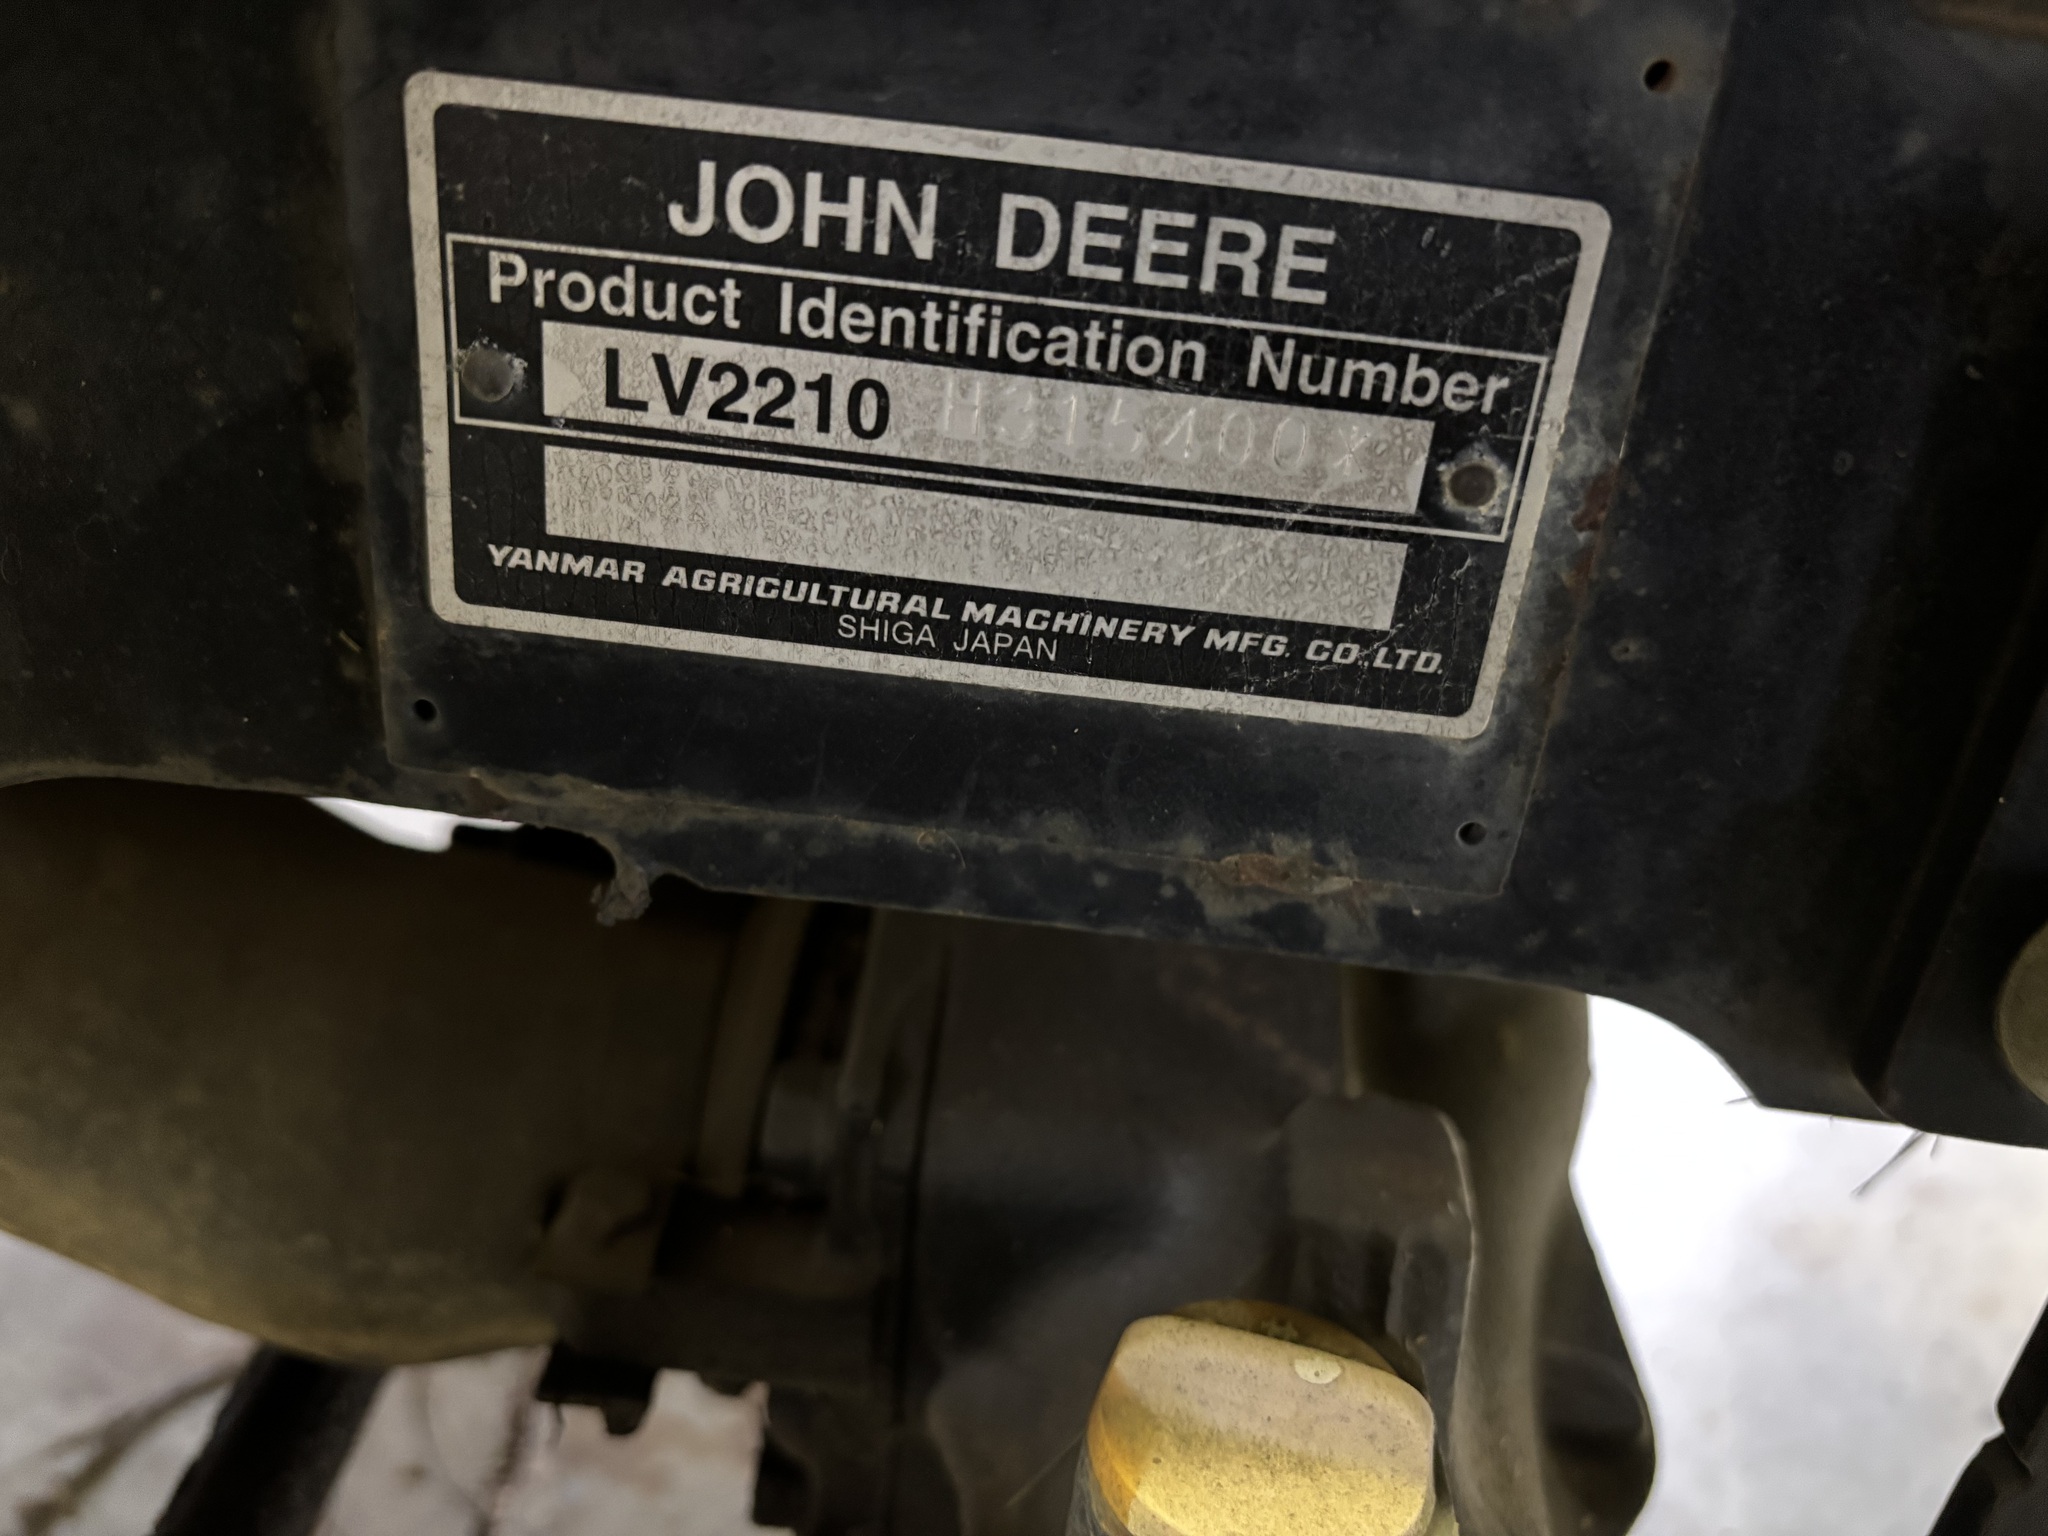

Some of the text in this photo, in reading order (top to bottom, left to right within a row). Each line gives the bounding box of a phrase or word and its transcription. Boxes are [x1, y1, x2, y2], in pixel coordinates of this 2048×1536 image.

[668, 160, 1337, 305] JOHN DEERE
[487, 250, 1510, 415] Product Identification Number
[604, 347, 891, 440] LV2210
[486, 543, 646, 583] YANMAR
[661, 565, 951, 620] AGRICULTURAL
[960, 600, 1196, 647] MACHINERY
[1203, 627, 1291, 658] MFG.
[837, 614, 1059, 663] SHIGA JAPAN
